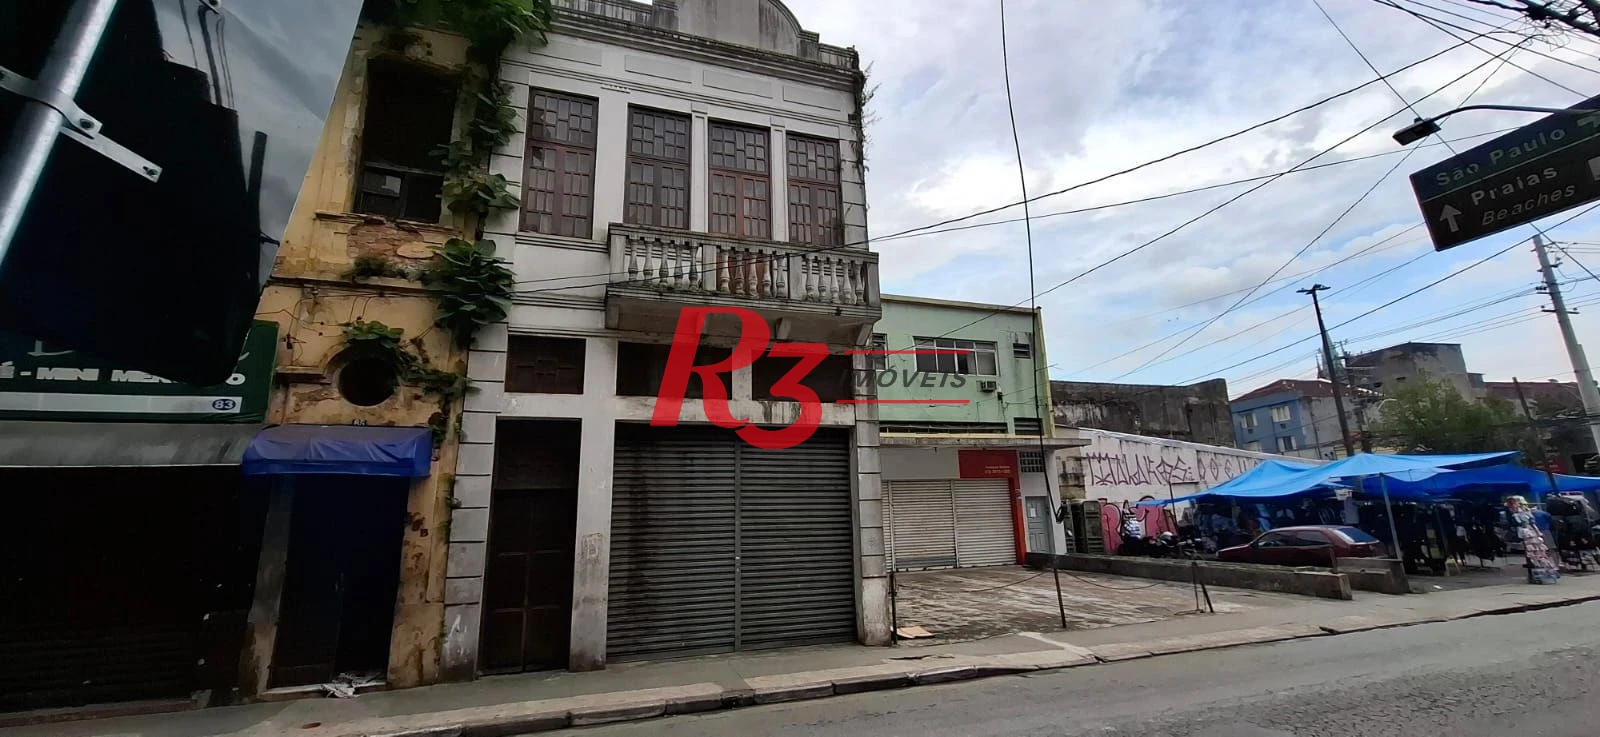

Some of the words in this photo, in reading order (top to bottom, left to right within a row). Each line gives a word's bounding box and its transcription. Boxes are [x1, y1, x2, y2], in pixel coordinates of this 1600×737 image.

[1436, 162, 1480, 186] São
[1489, 128, 1566, 165] Paulo
[1471, 167, 1558, 206] Praias
[1481, 185, 1576, 226] Beaches
[36, 367, 99, 381] MINI
[215, 400, 233, 410] 83
